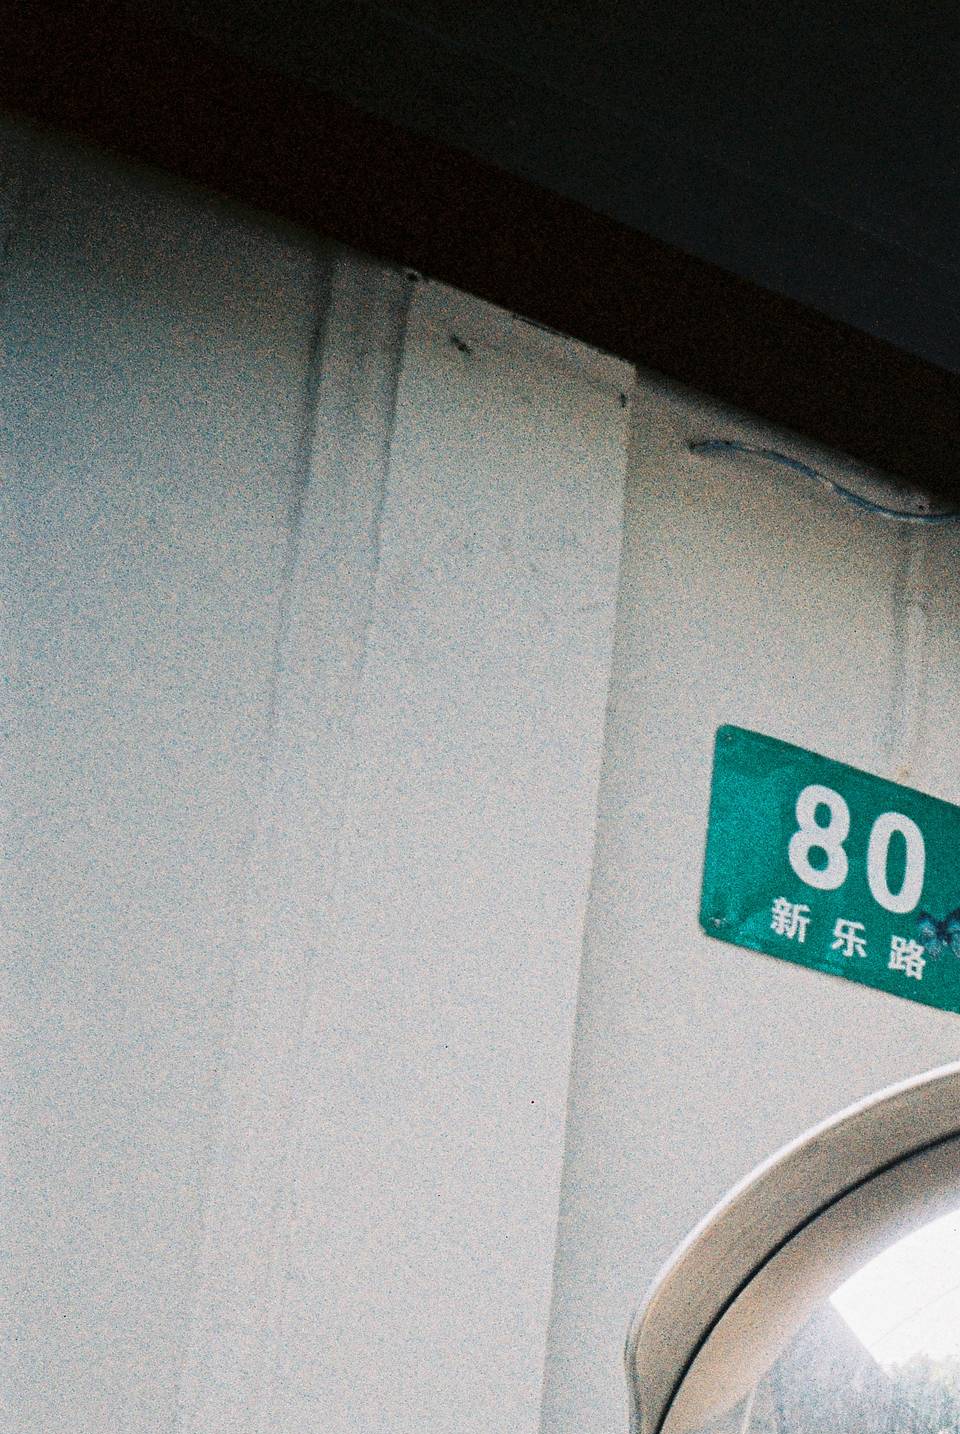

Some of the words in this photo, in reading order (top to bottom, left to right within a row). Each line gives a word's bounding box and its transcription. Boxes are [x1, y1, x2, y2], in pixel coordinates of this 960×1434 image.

[788, 784, 926, 914] 80
[770, 896, 926, 980] 新乐路
